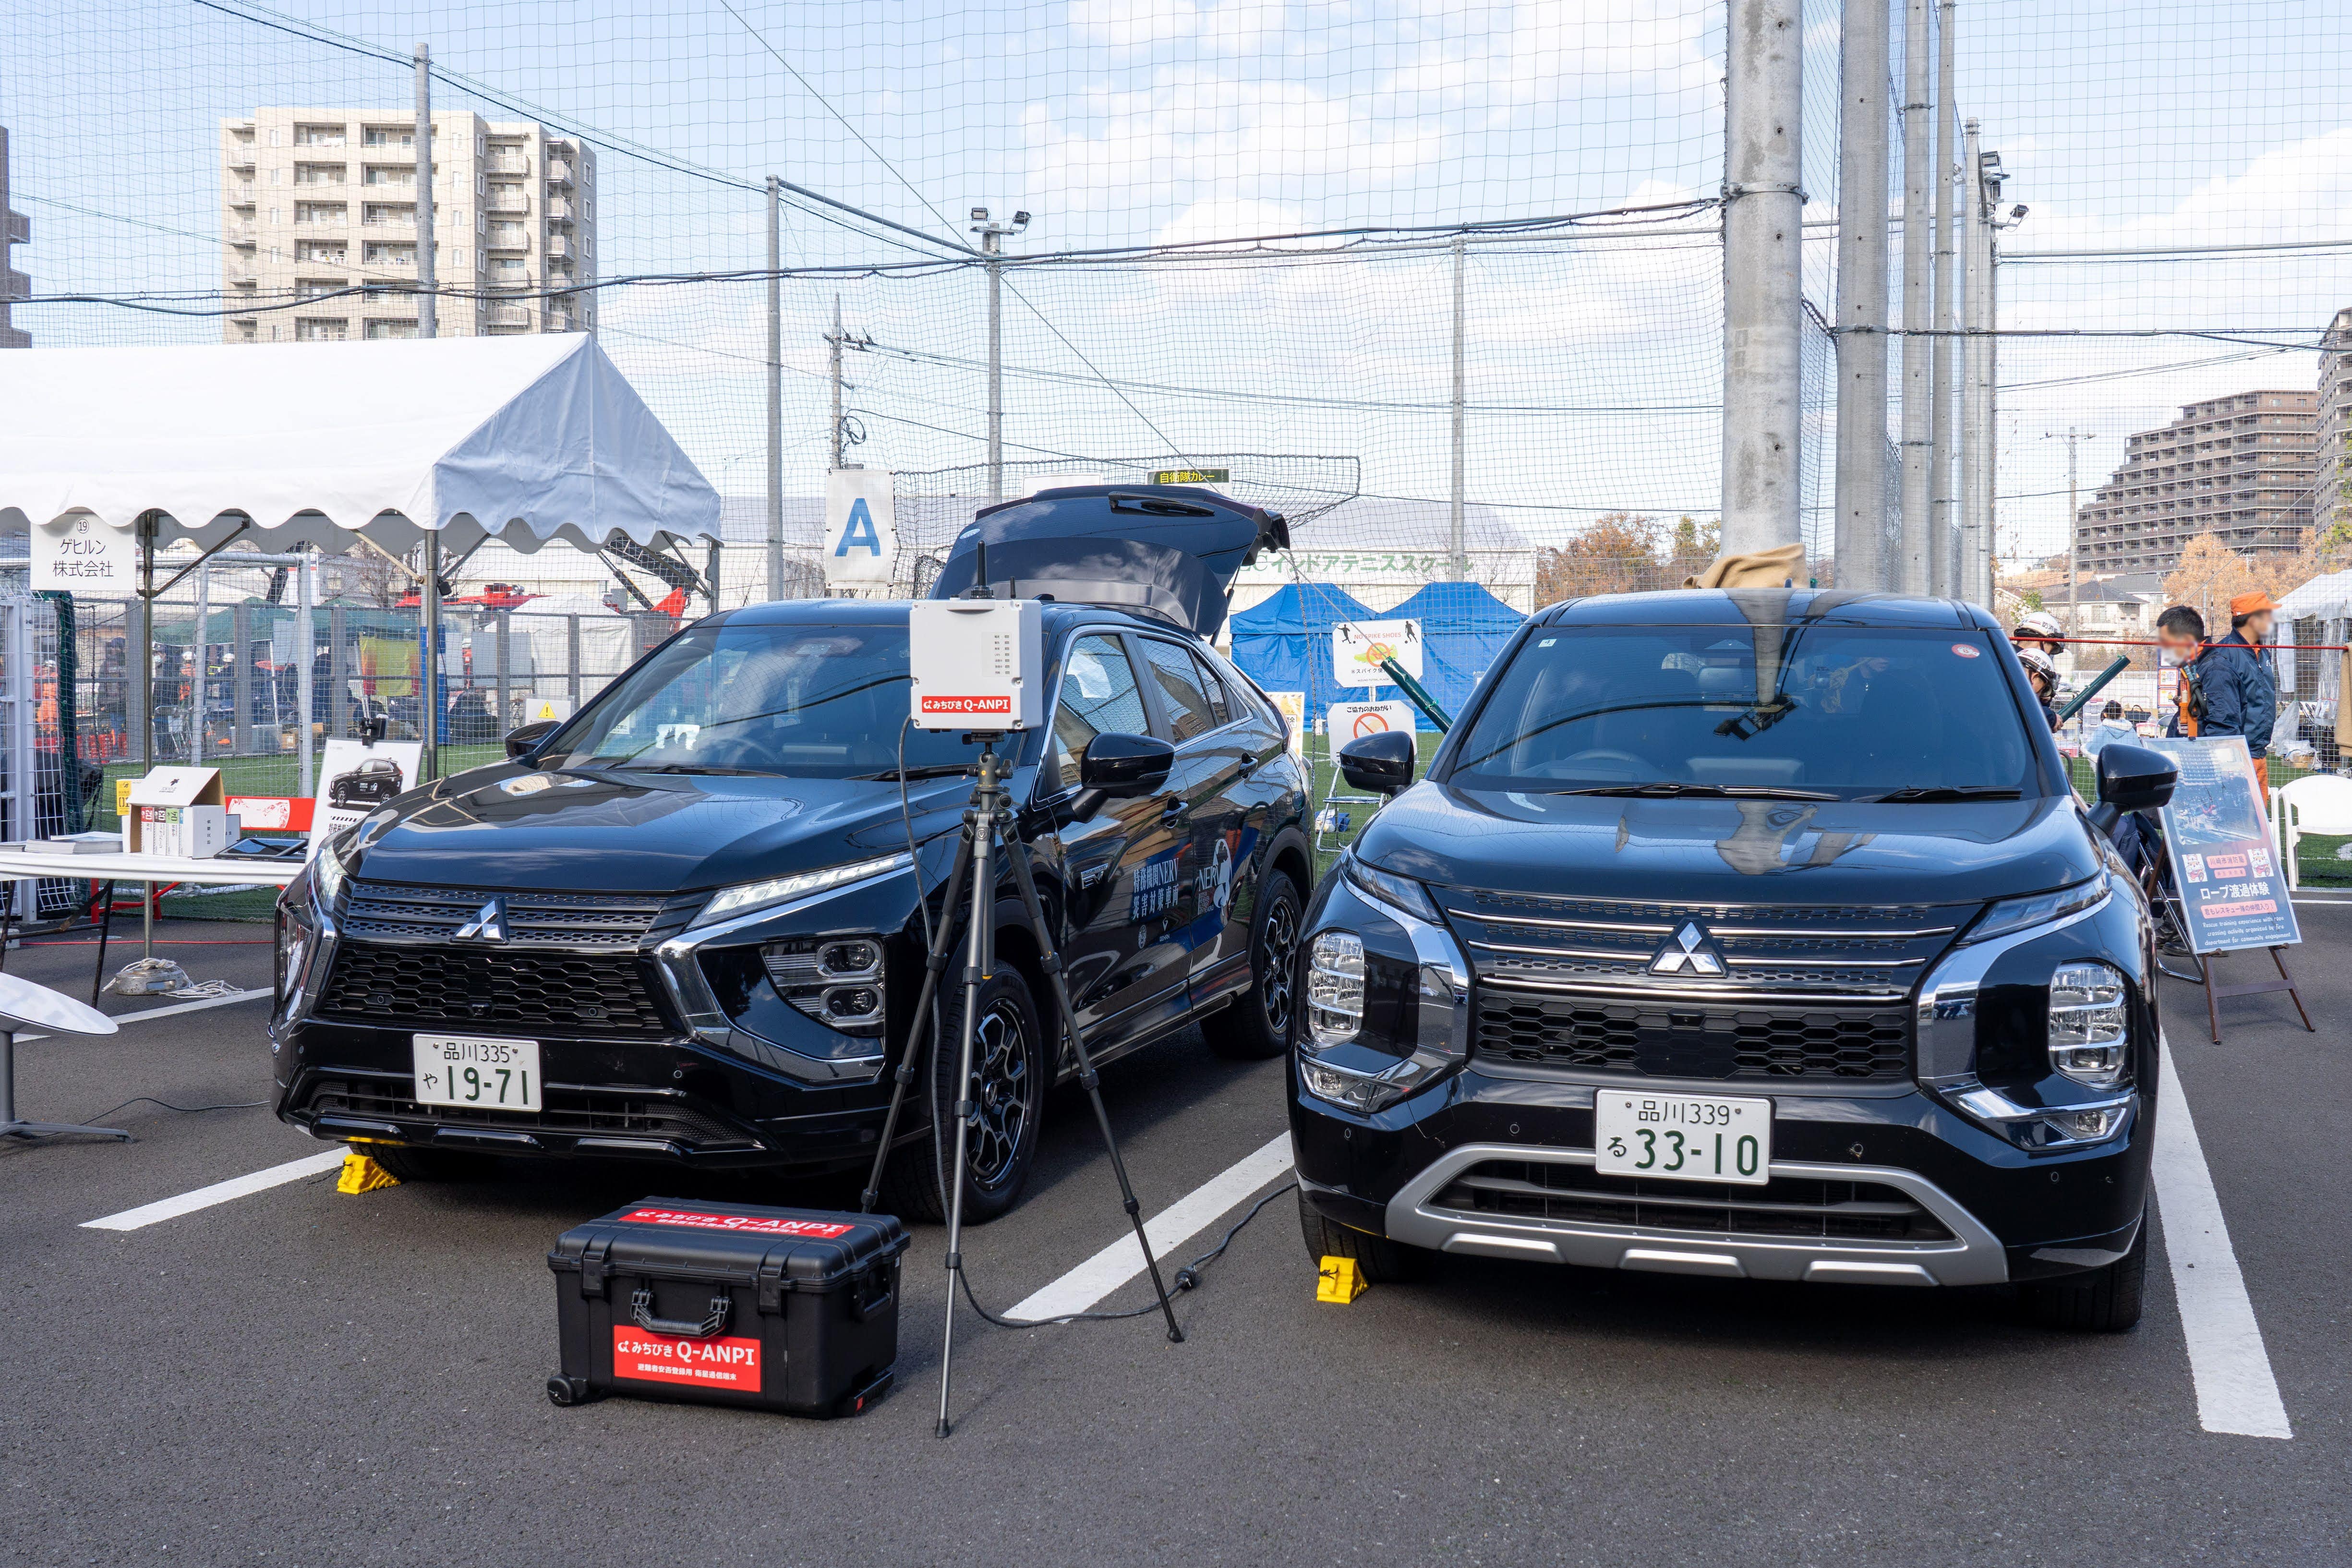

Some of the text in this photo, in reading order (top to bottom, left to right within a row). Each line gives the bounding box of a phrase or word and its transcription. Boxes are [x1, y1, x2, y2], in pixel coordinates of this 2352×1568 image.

[1160, 472, 1215, 483] 自衛隊カレー
[834, 498, 880, 557] A
[60, 539, 106, 554] ゲヒルン
[53, 560, 114, 577] 株式会社
[933, 699, 1008, 712] みちびき Q-ANPI
[145, 810, 152, 820] 02
[158, 810, 166, 820] 03
[2200, 881, 2270, 900] ロープ渡過体験
[1133, 883, 1179, 920] 災害対策車両
[444, 1042, 510, 1063] 品川335
[423, 1065, 529, 1105] や 19-71
[1639, 1100, 1729, 1125] 品川339
[1607, 1128, 1758, 1176] る 33-10
[655, 1213, 844, 1232] みちびき Q-ANPI
[632, 1341, 755, 1365] みちびき Q-ANPI
[638, 1363, 737, 1381] 避難者安否登録用 衛星通信端末
